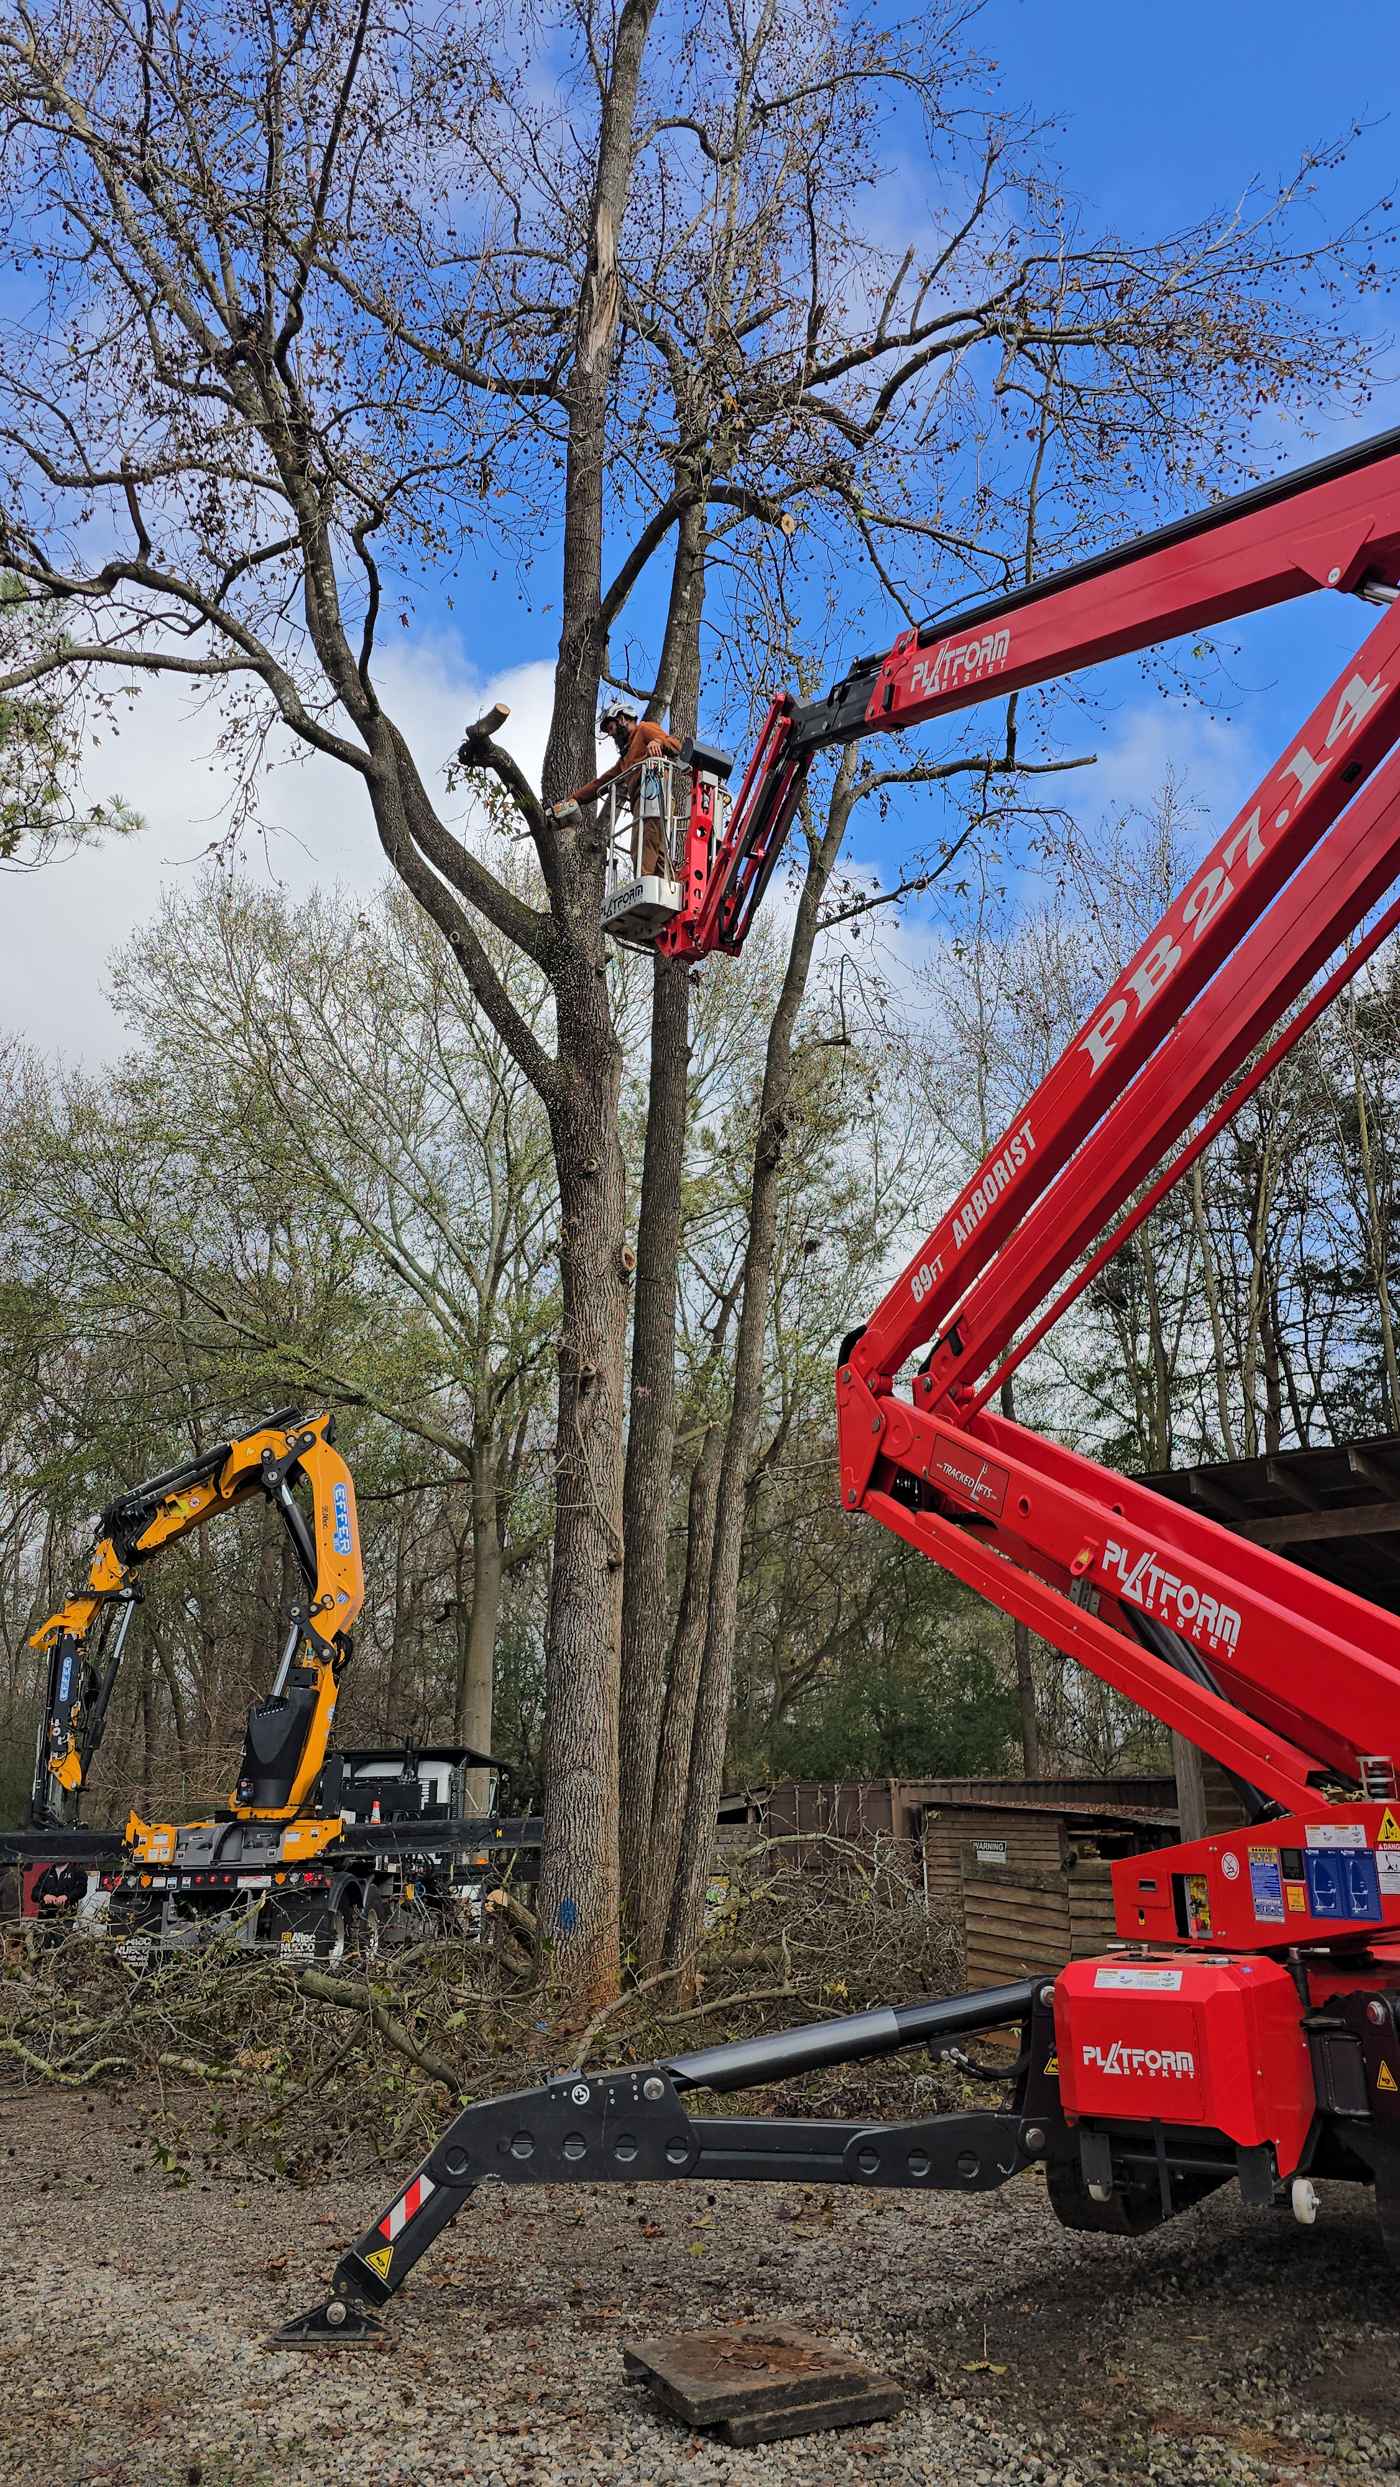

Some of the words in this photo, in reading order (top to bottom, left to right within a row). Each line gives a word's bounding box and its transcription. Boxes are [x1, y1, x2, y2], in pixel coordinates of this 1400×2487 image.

[910, 628, 1010, 697] PLATFORM
[941, 659, 1006, 690] BASKET
[1077, 934, 1183, 1078] PB
[1182, 672, 1389, 941] 27.14
[952, 1119, 1036, 1249] ARBORIST
[943, 1462, 975, 1488] TRACKED
[334, 1487, 351, 1552] EFFER
[1102, 1539, 1242, 1647] PLATFORM
[1145, 1597, 1235, 1659] BASKET
[1082, 2040, 1195, 2075] PLATFORM
[1123, 2068, 1196, 2079] BASKET
